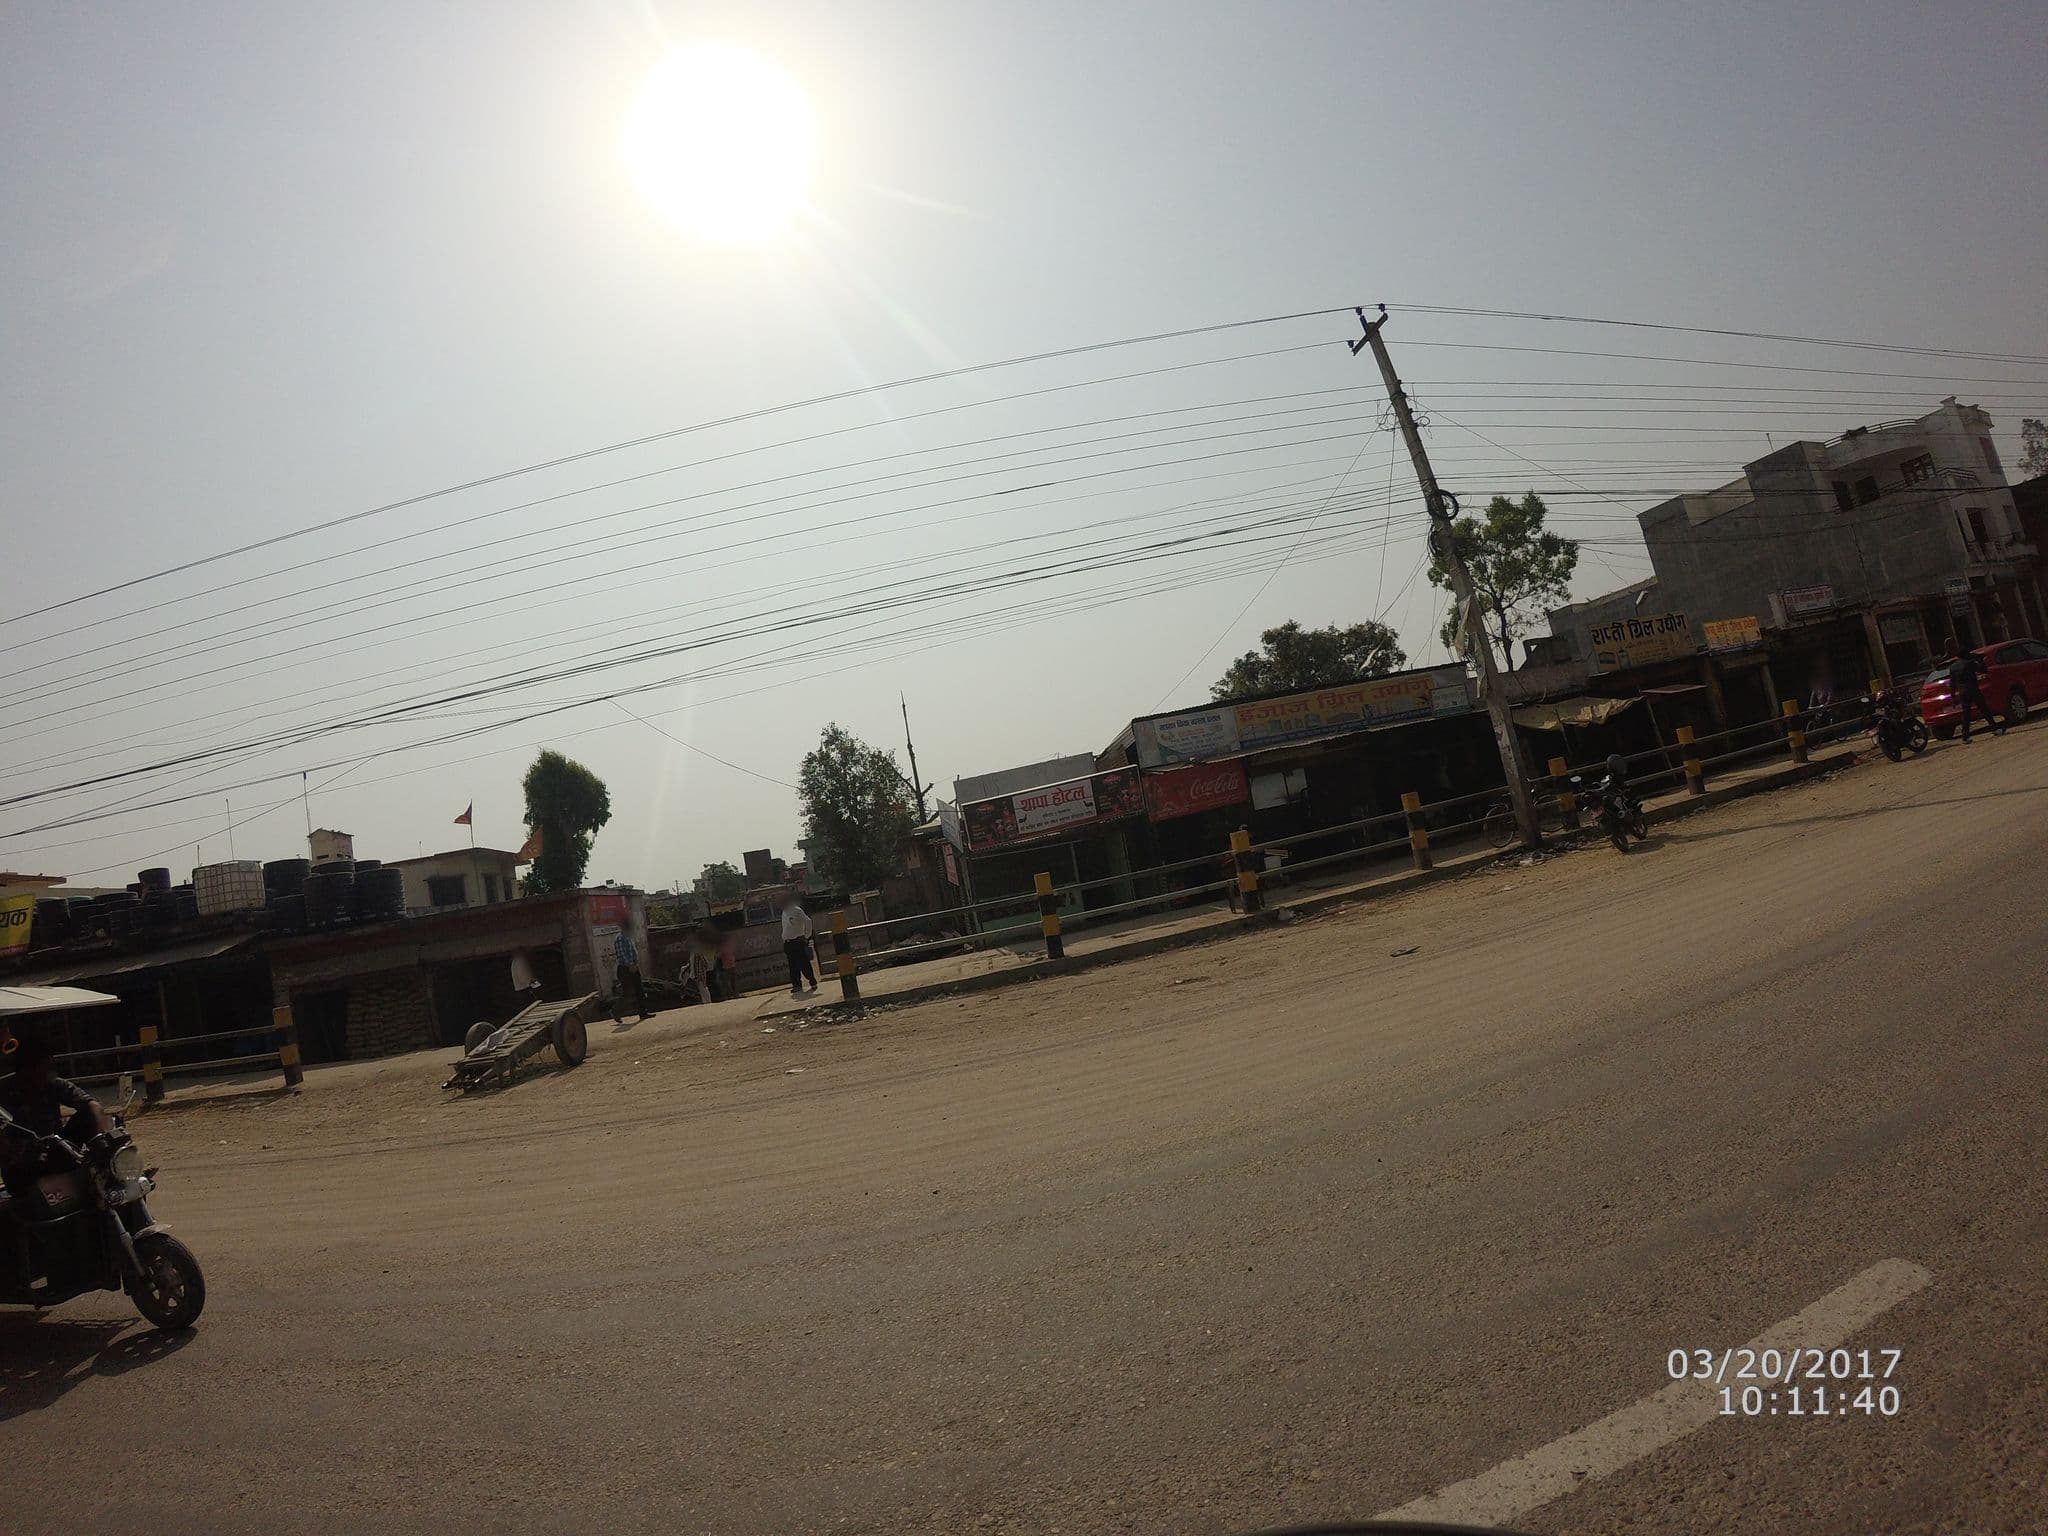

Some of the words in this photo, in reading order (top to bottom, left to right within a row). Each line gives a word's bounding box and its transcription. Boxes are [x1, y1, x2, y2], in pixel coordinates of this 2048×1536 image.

[1591, 622, 1626, 645] राप्ती
[1627, 619, 1655, 640] ग्रिल
[1655, 613, 1687, 633] उद्योग
[1020, 795, 1048, 812] थापा
[1051, 787, 1085, 806] होटल
